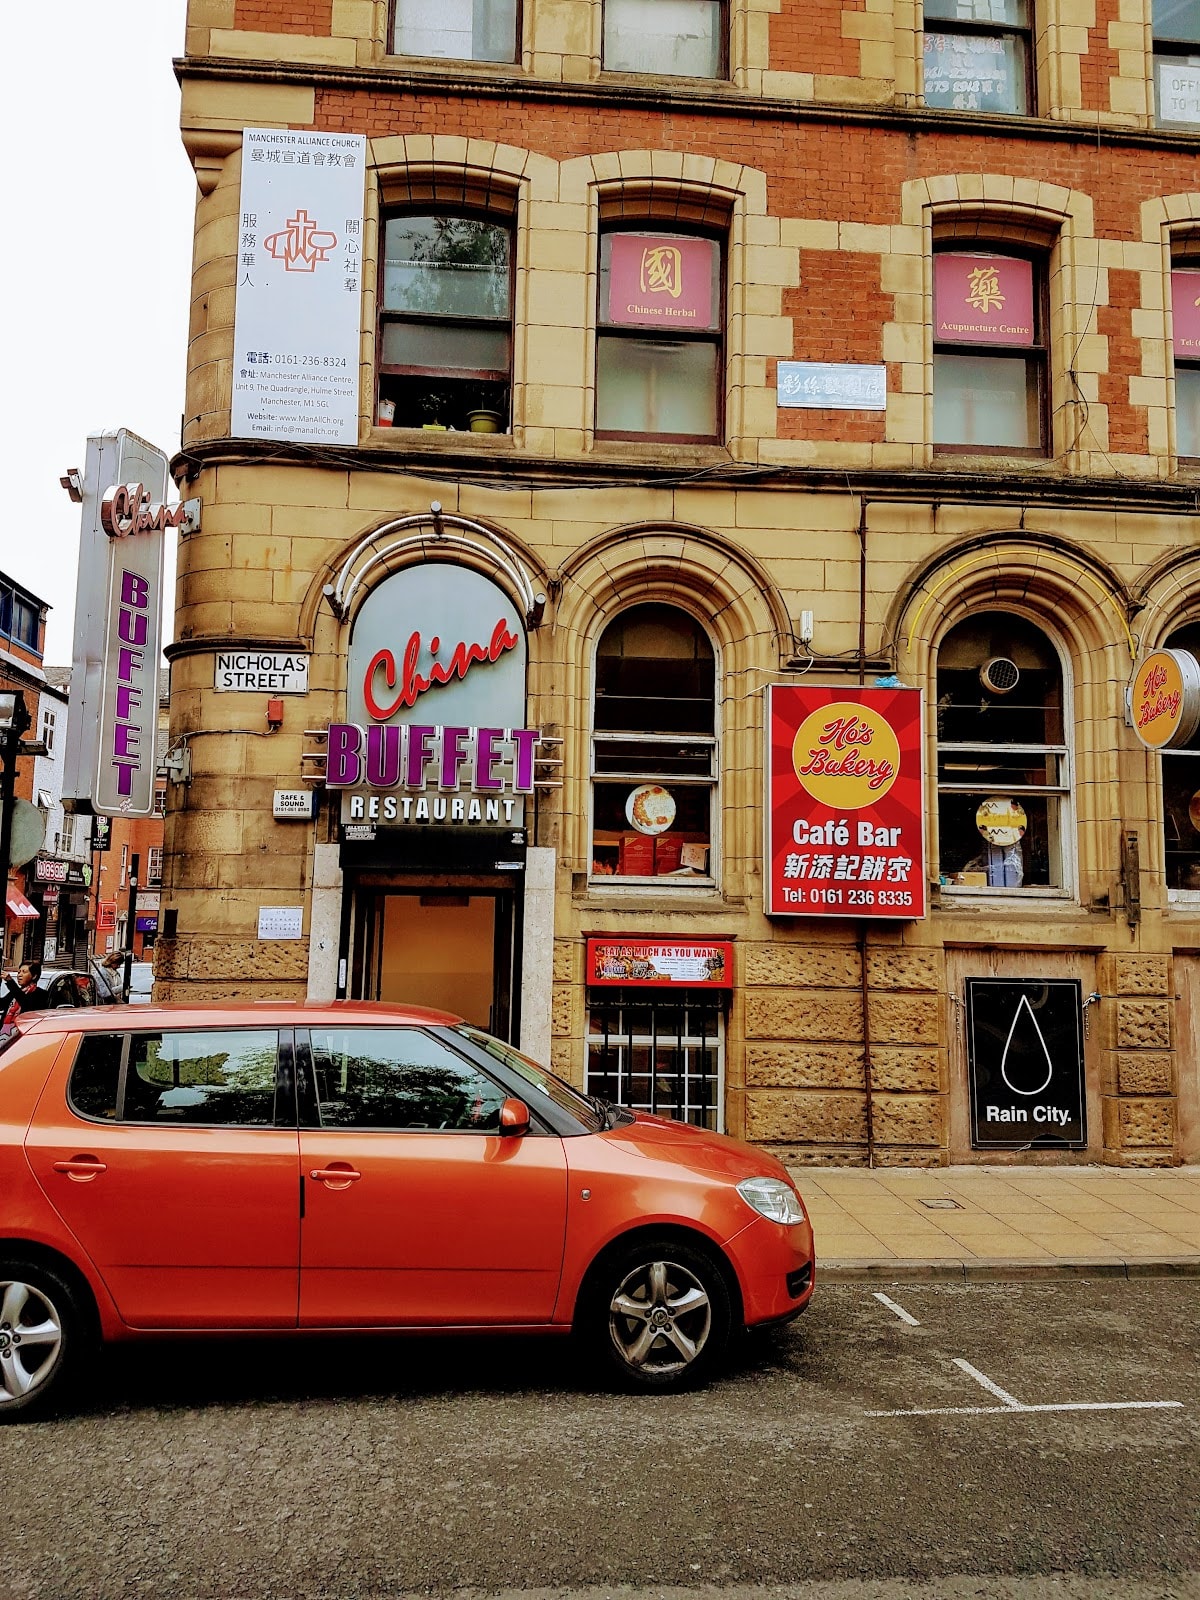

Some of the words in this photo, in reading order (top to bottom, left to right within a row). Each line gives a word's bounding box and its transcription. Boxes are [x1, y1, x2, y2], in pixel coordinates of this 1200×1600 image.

[1171, 97, 1186, 110] TO
[248, 134, 296, 144] MANCHESTER
[297, 137, 330, 146] ALLIANCE
[331, 139, 360, 148] CHURCH
[250, 149, 357, 168] 曼城宣道會教會
[240, 213, 257, 287] 服務華人
[964, 266, 1006, 314] 藥
[626, 304, 663, 315] Chinese
[665, 307, 696, 317] Herbal
[940, 321, 997, 334] Acupuncture
[999, 324, 1029, 334] Centre
[1181, 338, 1194, 346] Tel:
[246, 352, 272, 364] 電話:
[274, 354, 347, 367] 0161-236-8324
[260, 371, 300, 380] Manchester
[301, 373, 327, 382] Alliance
[329, 375, 354, 384] Centre,
[235, 383, 249, 391] Unit
[256, 383, 269, 392] The
[270, 385, 309, 395] Quadrangle,
[310, 386, 332, 395] Hulme
[333, 387, 355, 397] Street,
[260, 397, 301, 407] Manchester,
[303, 399, 314, 407] M1
[247, 412, 278, 421] Website:
[252, 424, 274, 432] Email:
[104, 483, 188, 538] China
[218, 655, 306, 672] NICHOLAS
[363, 617, 519, 721] China
[111, 568, 150, 797] BUFFET
[223, 672, 289, 688] STREET
[1138, 690, 1180, 728] Bakery
[819, 716, 874, 750] Ho's
[326, 723, 543, 792] BUFFET
[800, 748, 894, 789] Bakery
[350, 795, 516, 822] RESTAURANT
[792, 819, 850, 846] Café
[857, 821, 902, 847] Bar
[783, 853, 913, 882] 新添記餅家
[782, 887, 806, 903] Tel:
[810, 888, 843, 904] 0161
[848, 889, 874, 905] 236
[878, 890, 912, 906] 8335
[604, 946, 619, 956] EAT
[620, 946, 632, 956] AS
[633, 947, 659, 957] MUCH
[661, 948, 672, 957] AS
[675, 948, 691, 957] YOU
[693, 949, 718, 958] WANT
[986, 1105, 1028, 1122] Rain
[1032, 1105, 1072, 1126] City.
